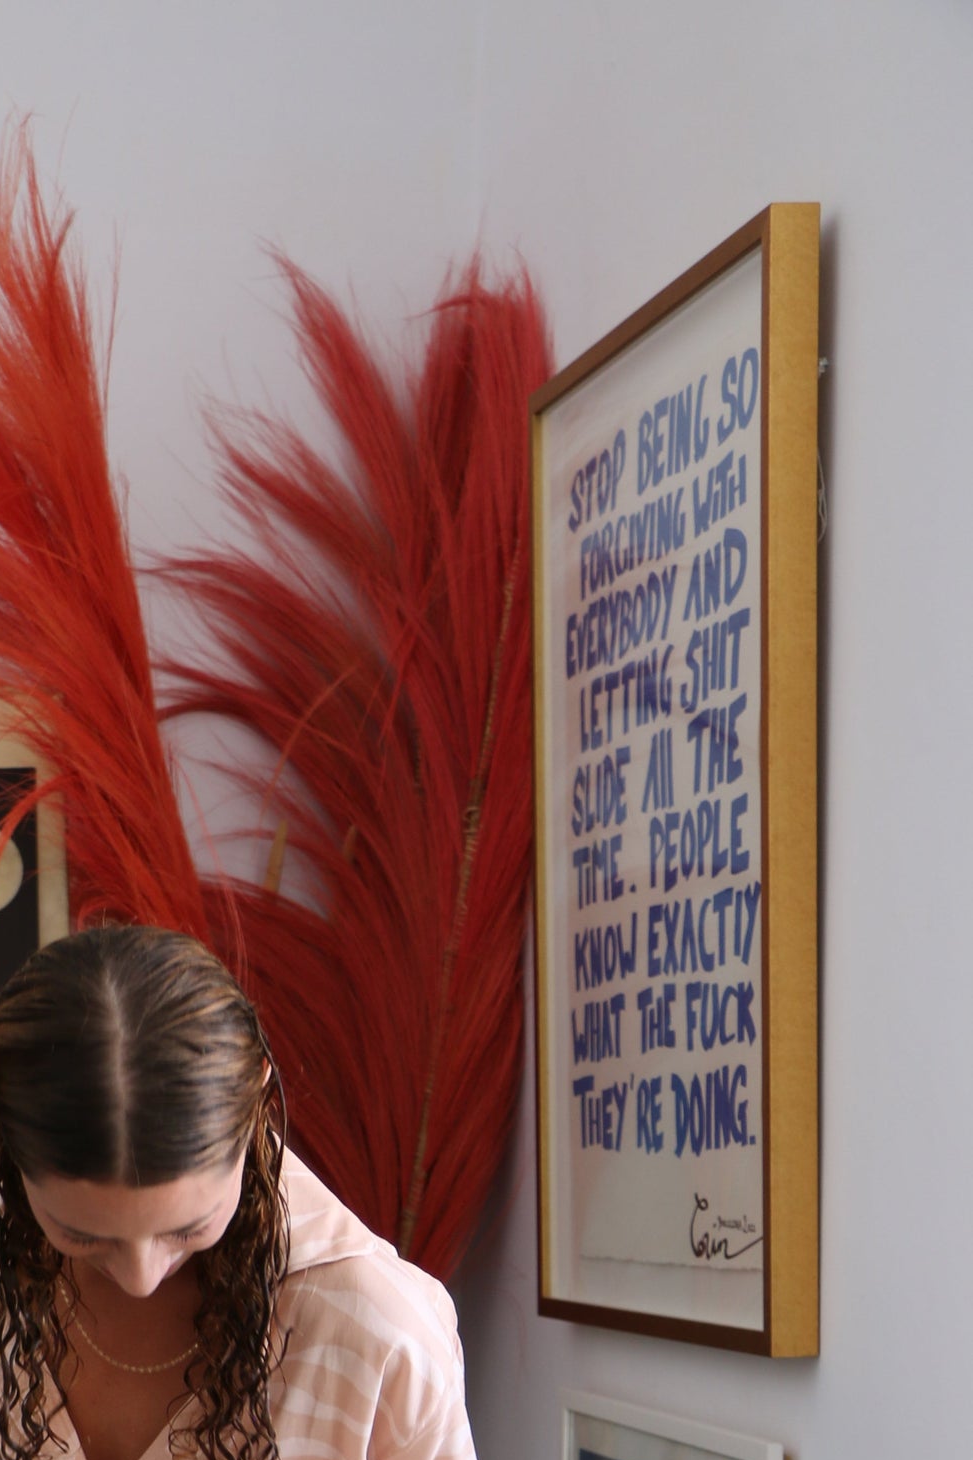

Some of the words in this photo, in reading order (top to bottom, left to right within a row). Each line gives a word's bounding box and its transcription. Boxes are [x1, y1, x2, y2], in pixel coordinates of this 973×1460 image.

[568, 428, 626, 533] STOP
[637, 374, 709, 498] BEING
[717, 346, 759, 446] SO
[579, 487, 685, 602] FORGIVING
[692, 450, 747, 538] WITH
[566, 563, 678, 681] EVERYBODY
[683, 527, 748, 622] AND
[579, 644, 675, 753] LETTING
[680, 607, 751, 714] SHIT
[571, 745, 631, 838] SLIDE
[686, 692, 748, 796] THE
[649, 793, 750, 893] PEOPLE
[572, 993, 625, 1065] WHAT
[637, 983, 677, 1055] THE
[686, 980, 757, 1052] FUCK
[575, 912, 638, 992] KNOW
[573, 1073, 665, 1155] THEY'RE
[671, 1064, 756, 1158] DOING.
